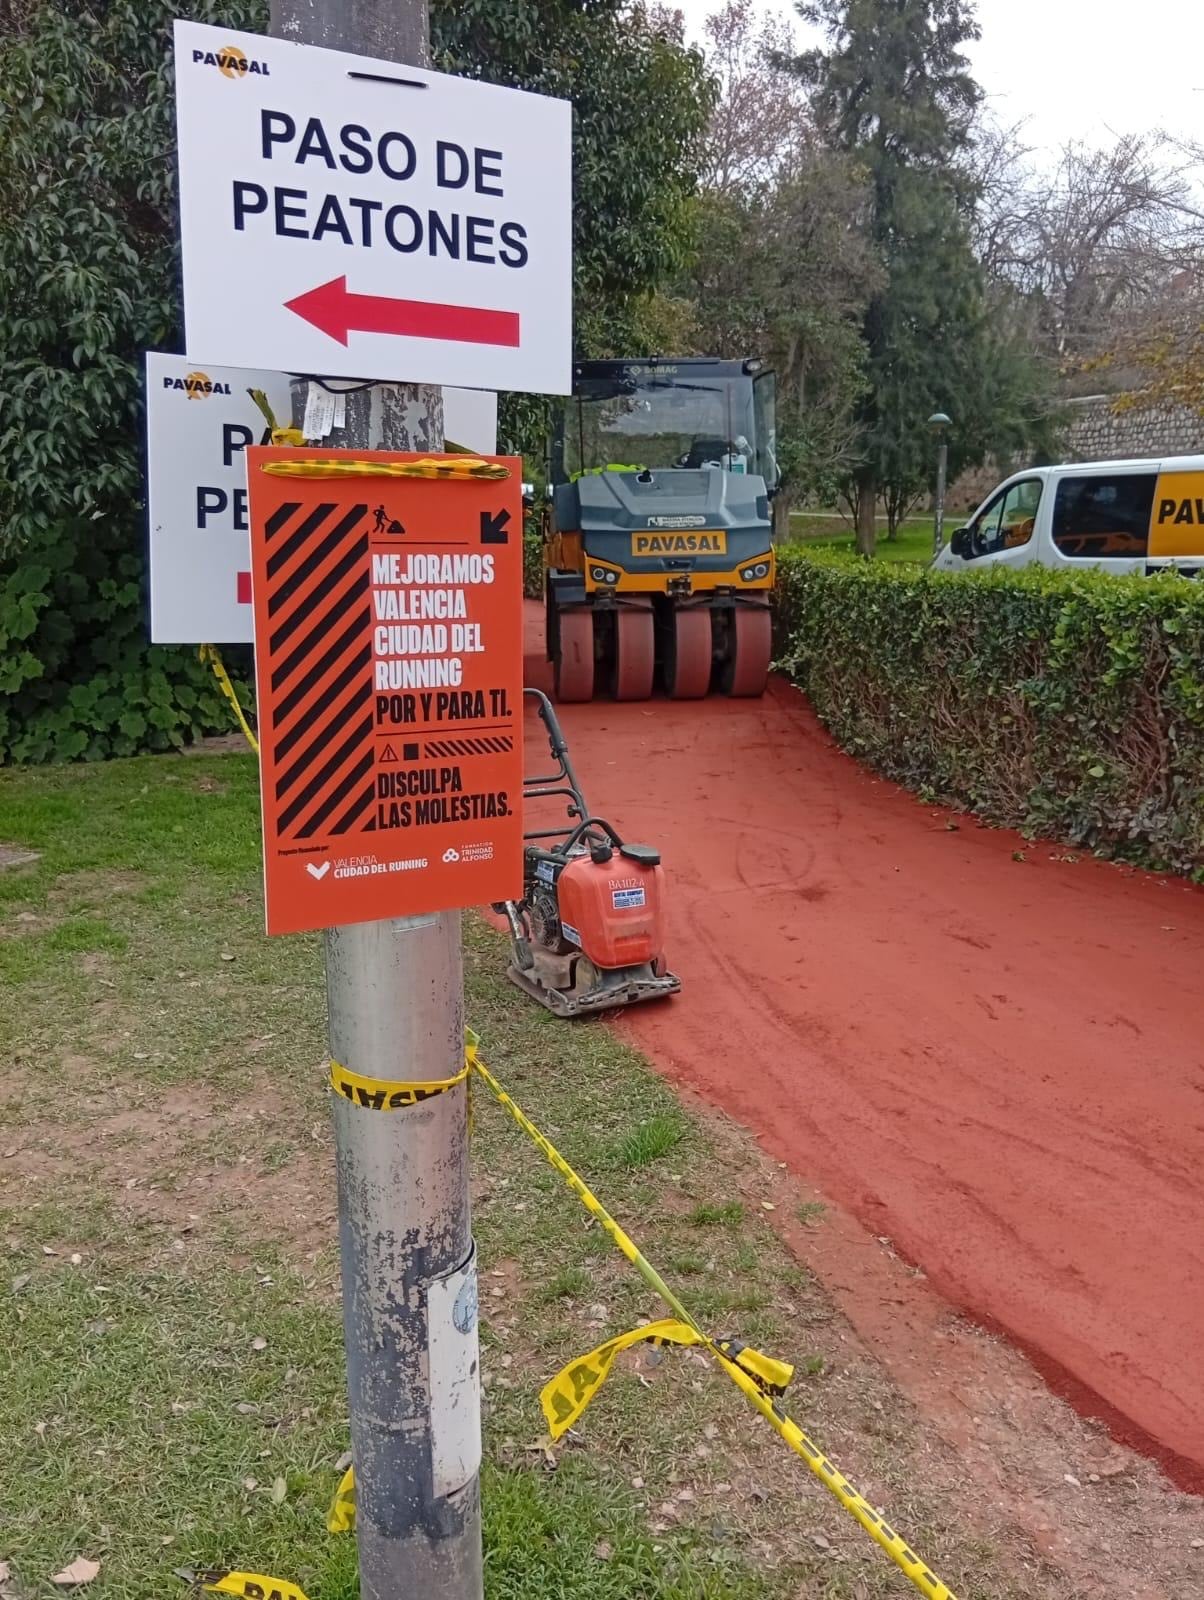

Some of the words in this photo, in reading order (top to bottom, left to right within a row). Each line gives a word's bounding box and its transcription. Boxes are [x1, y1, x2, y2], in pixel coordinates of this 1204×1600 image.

[192, 49, 270, 76] PAVASAL
[261, 109, 417, 181] PASO
[436, 140, 504, 197] DE
[232, 180, 529, 268] PEATONES
[163, 376, 232, 396] PAVASAL
[637, 535, 721, 552] PAVASAL
[372, 554, 495, 584] MEJORAMOS
[373, 589, 467, 620] VALENCIA
[374, 624, 448, 655] CIUDAD
[451, 623, 485, 652] DEL
[375, 658, 462, 690] RUNNING
[376, 694, 416, 725] POR
[419, 692, 433, 722] Y
[437, 690, 486, 721] PARA
[489, 688, 512, 717] TI.
[377, 766, 462, 799] DISCULPA
[379, 799, 412, 829] LAS
[415, 792, 512, 825] MOLESTIAS.
[333, 855, 378, 868] VALENCIA
[334, 865, 369, 879] CIUDAD
[371, 862, 388, 874] DEL
[461, 853, 494, 862] ALFONSO
